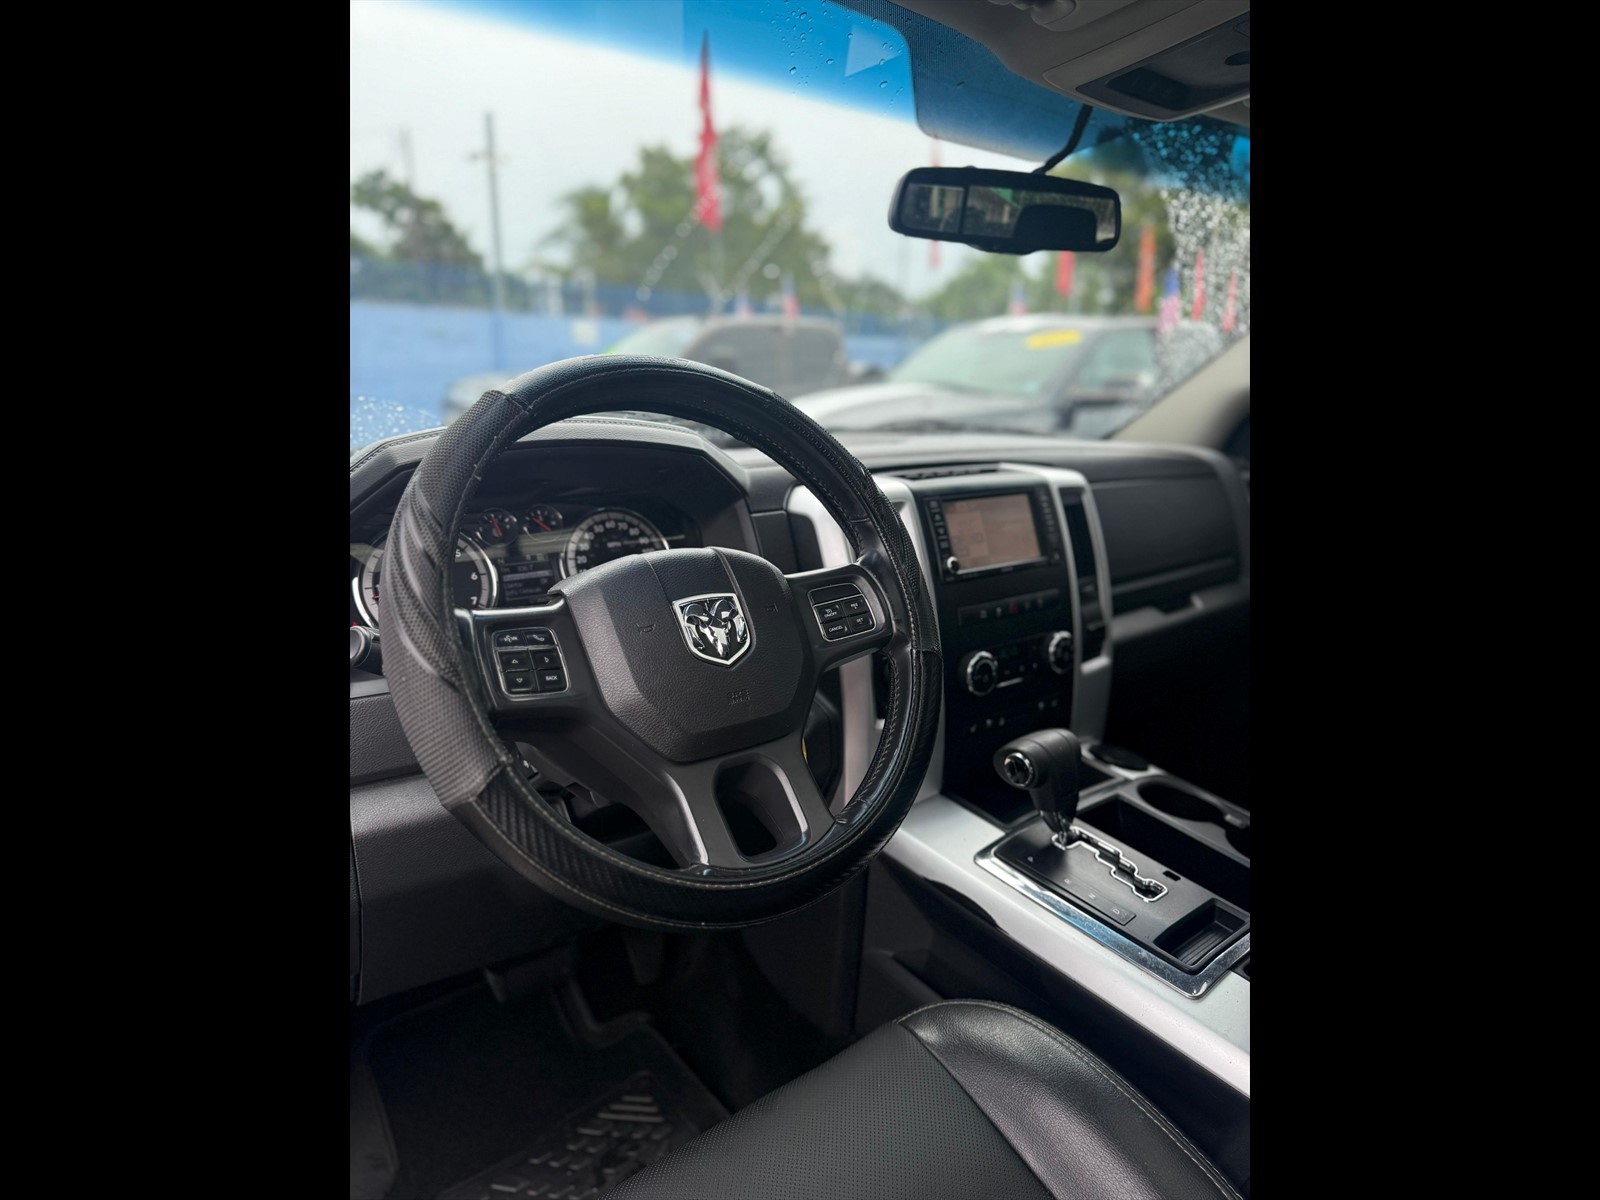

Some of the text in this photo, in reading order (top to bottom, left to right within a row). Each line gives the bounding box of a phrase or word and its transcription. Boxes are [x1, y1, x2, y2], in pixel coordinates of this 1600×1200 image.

[593, 524, 604, 533] 50
[605, 520, 616, 529] 60
[617, 522, 628, 531] 70
[455, 549, 462, 558] 5
[576, 555, 588, 564] 20
[470, 572, 478, 580] 6
[470, 596, 478, 605] 7
